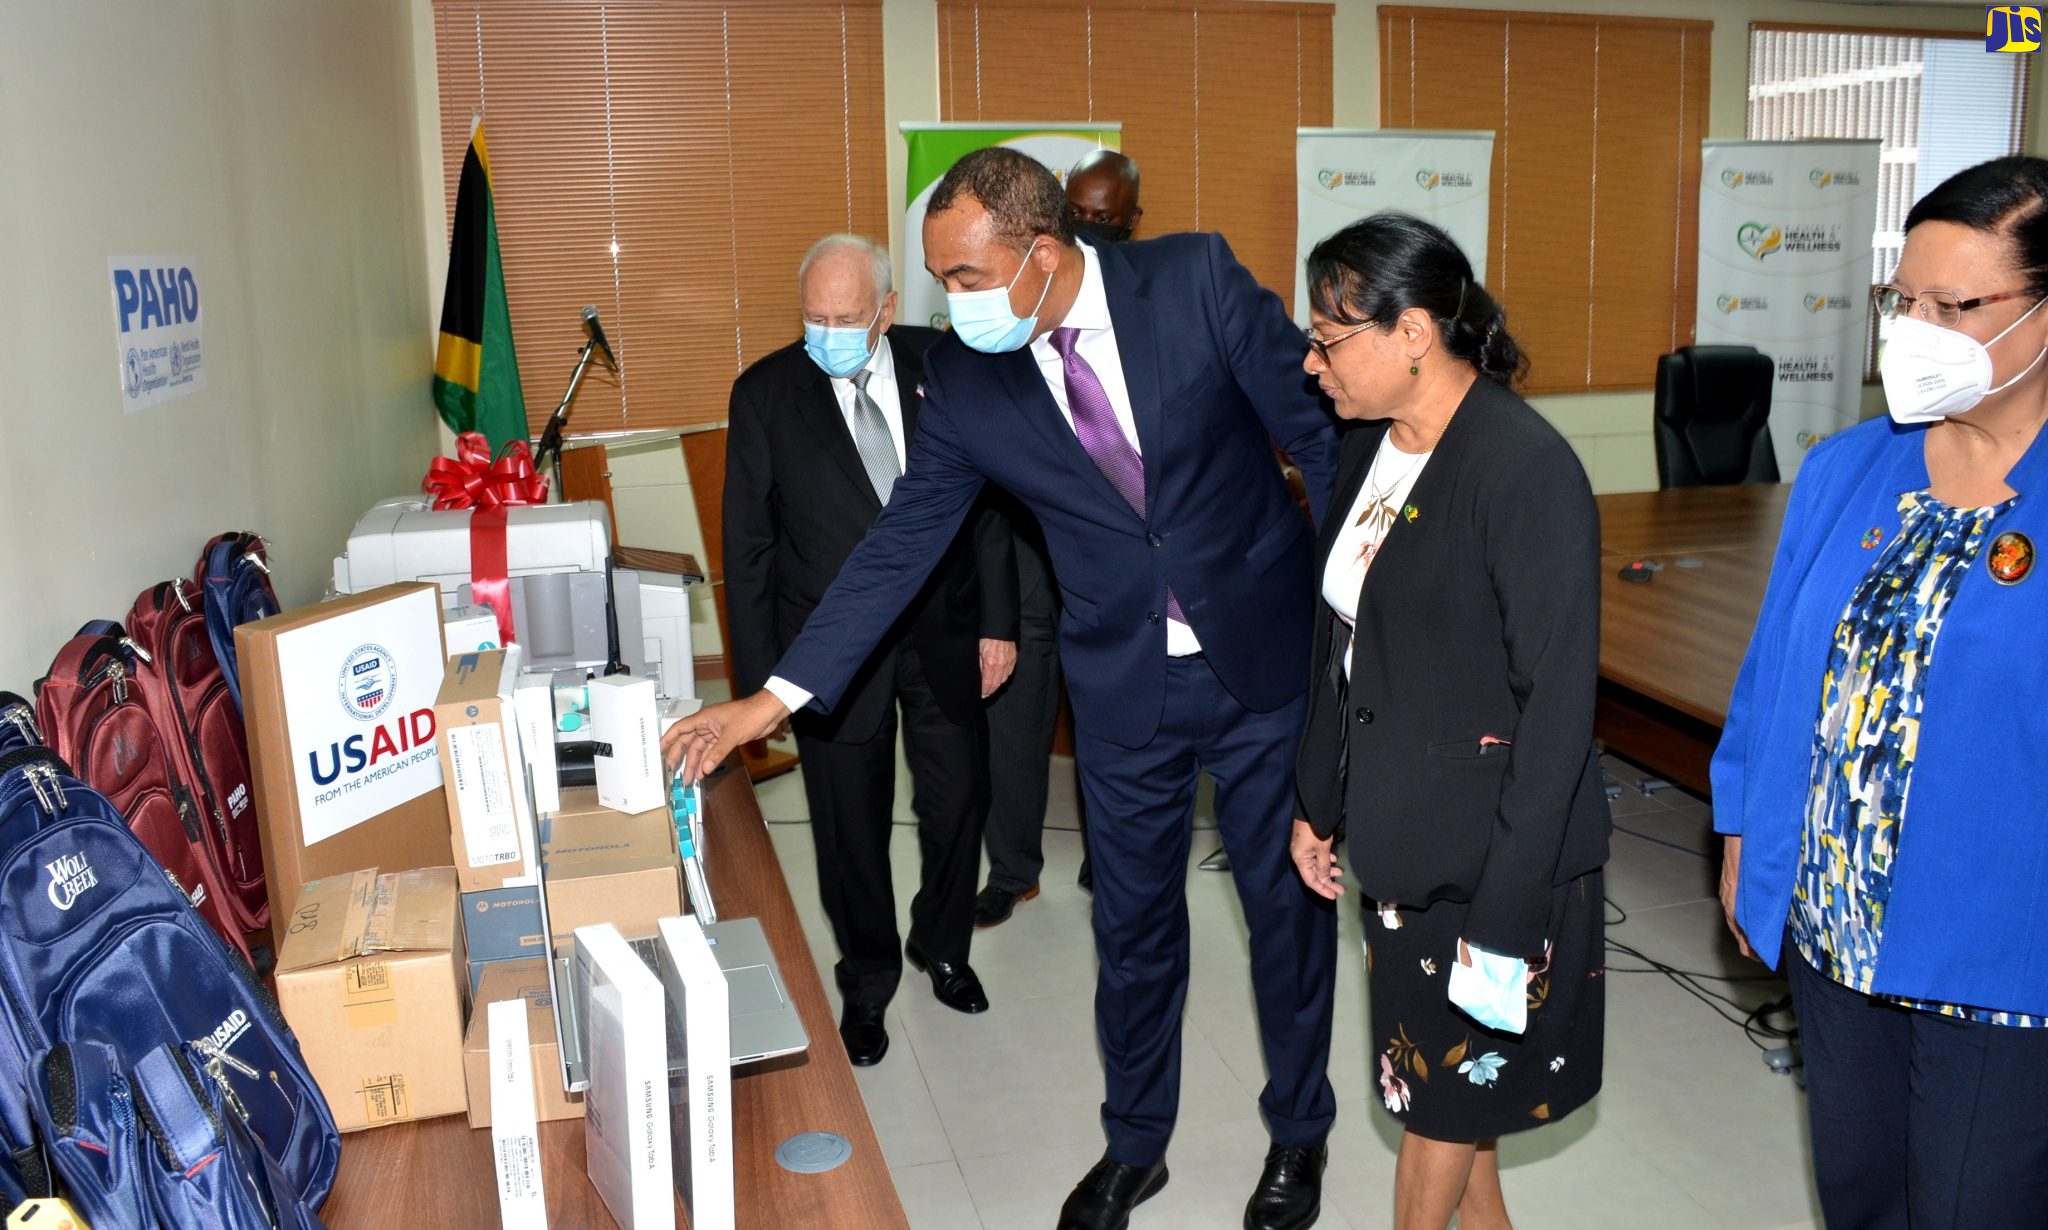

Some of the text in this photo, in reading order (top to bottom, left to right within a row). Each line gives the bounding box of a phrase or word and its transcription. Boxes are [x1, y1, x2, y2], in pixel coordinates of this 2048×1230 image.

[1785, 232, 1825, 241] HEALTH
[1785, 243, 1841, 253] WELLNESS
[114, 267, 199, 333] PAHO
[1778, 362, 1817, 371] HEALTH
[1778, 373, 1834, 382] WELLNESS
[341, 645, 392, 678] UNITED STATES AGENCY
[355, 660, 378, 674] USAID
[340, 691, 374, 719] INTERNATIONAL
[308, 708, 437, 786] USAID
[314, 787, 342, 806] FROM
[343, 778, 362, 794] THE
[363, 758, 409, 786] AMERICAN
[227, 783, 246, 810] PAHO
[555, 843, 631, 855] MOTOROLA
[211, 1009, 247, 1048] USAID
[644, 1080, 653, 1119] SAMSUNG
[706, 1074, 714, 1113] SAMSUNG
[646, 1121, 654, 1149] Galaxy
[707, 1115, 715, 1142] Galaxy
[708, 1143, 716, 1157] Tab
